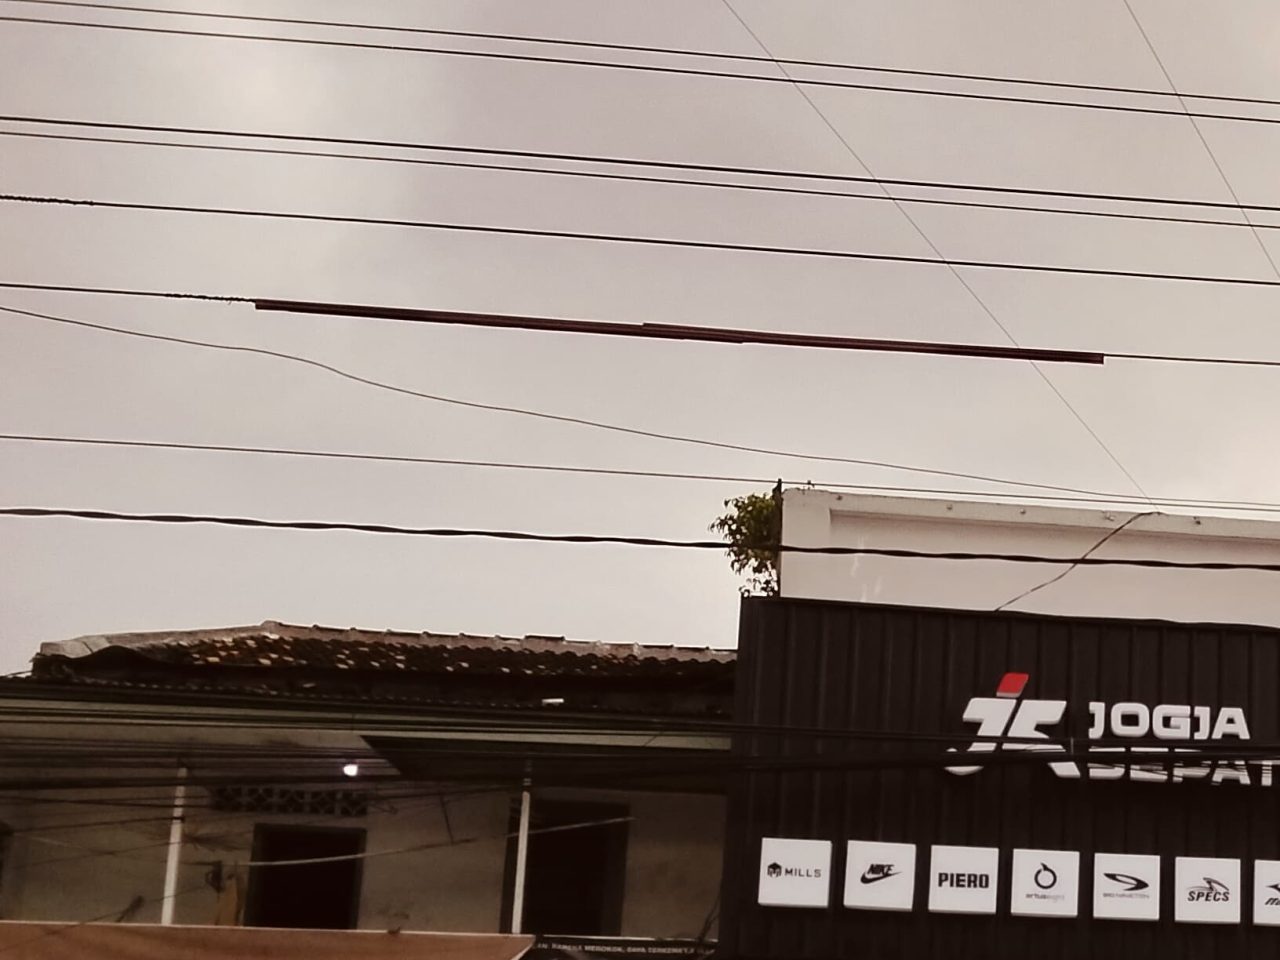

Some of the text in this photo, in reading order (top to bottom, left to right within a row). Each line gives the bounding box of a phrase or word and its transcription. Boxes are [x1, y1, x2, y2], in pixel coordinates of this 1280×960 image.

[1088, 701, 1251, 741] JOGJA
[784, 868, 822, 878] MILLS
[867, 863, 896, 875] NIKE
[938, 872, 990, 888] PIERO
[1187, 890, 1230, 902] SPECS
